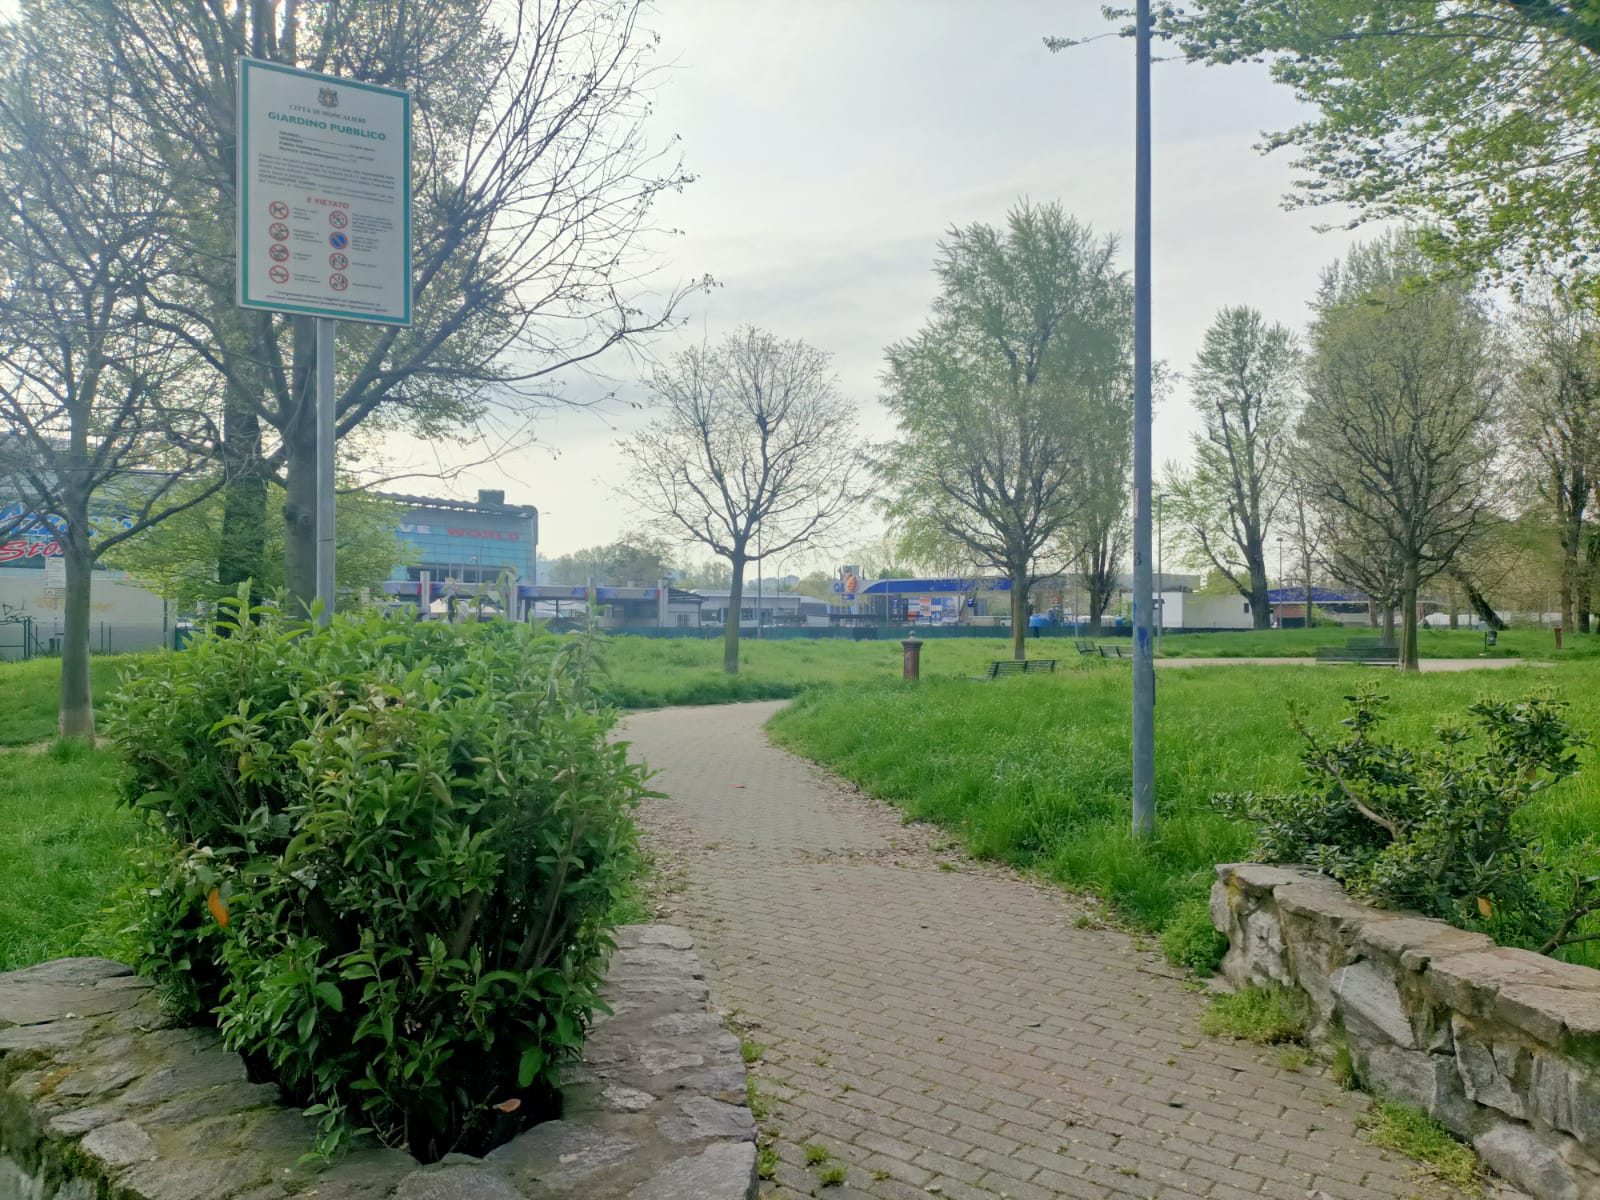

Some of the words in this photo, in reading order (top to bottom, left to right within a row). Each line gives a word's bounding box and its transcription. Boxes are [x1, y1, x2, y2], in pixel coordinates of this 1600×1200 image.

[268, 111, 327, 130] GIARDINO
[329, 123, 387, 141] PUBBLICO
[314, 198, 350, 209] VIETATO
[446, 527, 520, 541] WORLD
[0, 540, 64, 562] Sto
